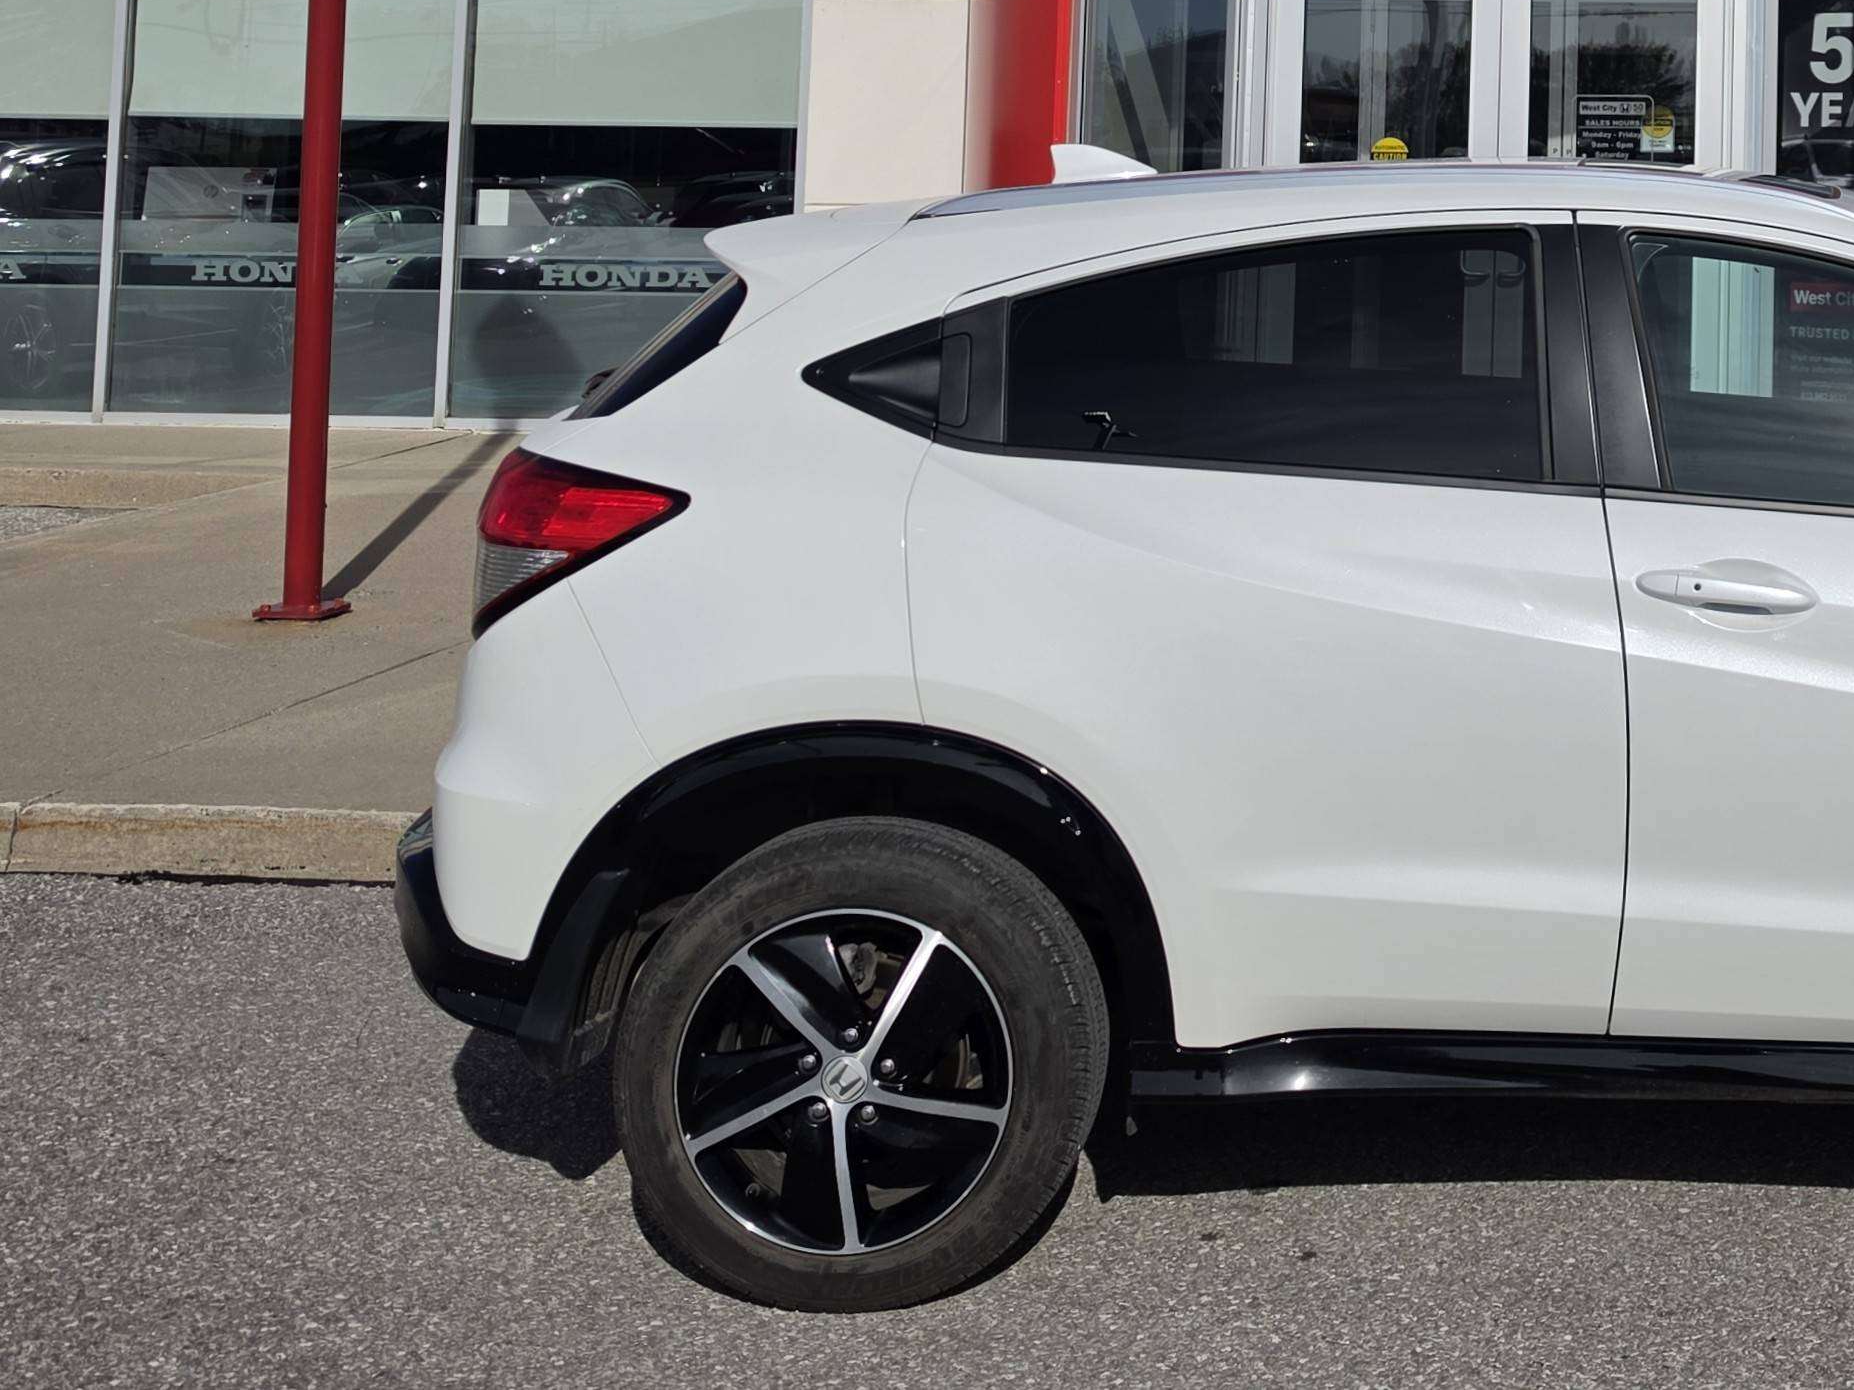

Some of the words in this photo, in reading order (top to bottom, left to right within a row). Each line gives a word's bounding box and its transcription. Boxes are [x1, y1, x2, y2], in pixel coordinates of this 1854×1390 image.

[1602, 104, 1617, 112] City
[1582, 131, 1612, 139] Monday
[1618, 131, 1642, 139] Friday
[1595, 151, 1630, 161] Saturday
[191, 261, 364, 285] HONA
[539, 264, 713, 288] HONDA
[1794, 289, 1832, 306] West
[1789, 325, 1850, 341] TRUSTED
